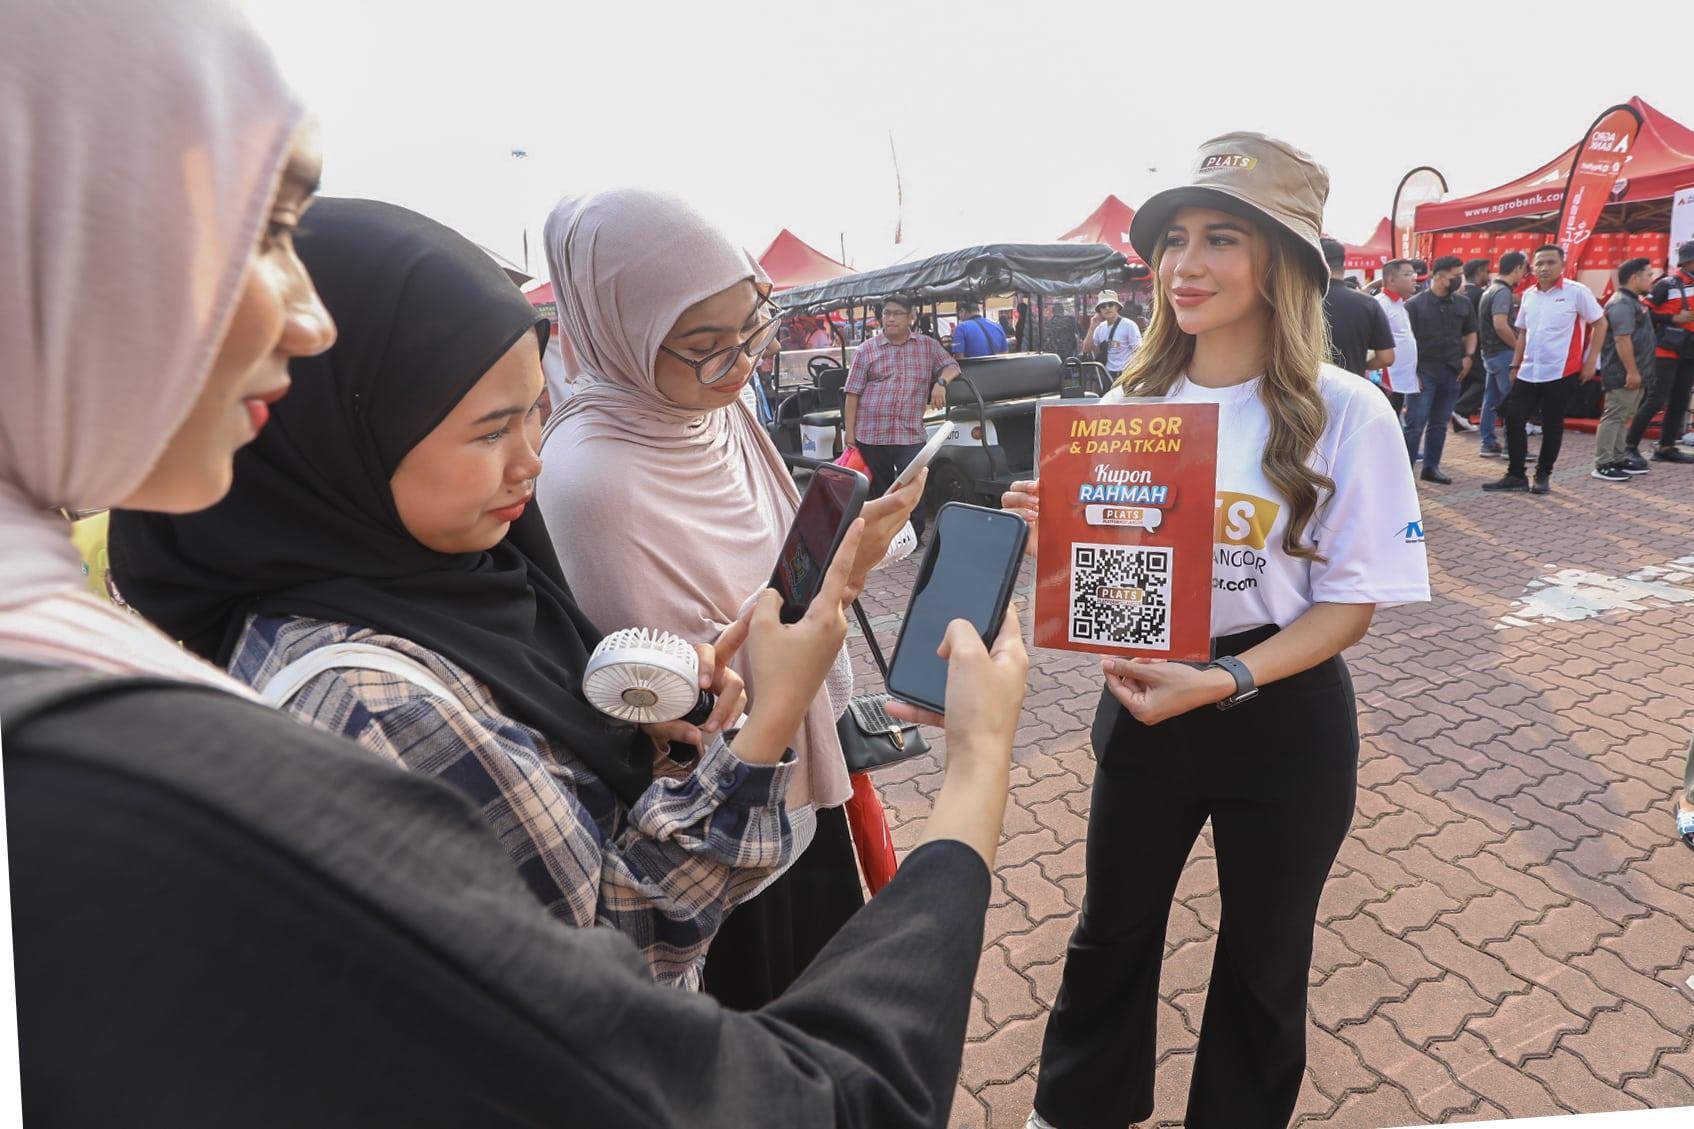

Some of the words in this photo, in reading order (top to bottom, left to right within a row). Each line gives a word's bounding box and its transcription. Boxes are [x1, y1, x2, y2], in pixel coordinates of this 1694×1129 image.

[1206, 155, 1250, 168] PLATS
[1070, 418, 1143, 437] IMBAS
[1148, 416, 1183, 437] QR
[1069, 441, 1082, 454] &
[1086, 439, 1182, 454] DAPATKAN
[1094, 463, 1152, 486] Kupon
[1079, 485, 1168, 503] RAHMAH
[1106, 509, 1140, 519] PLATS
[1101, 589, 1137, 600] PLATS
